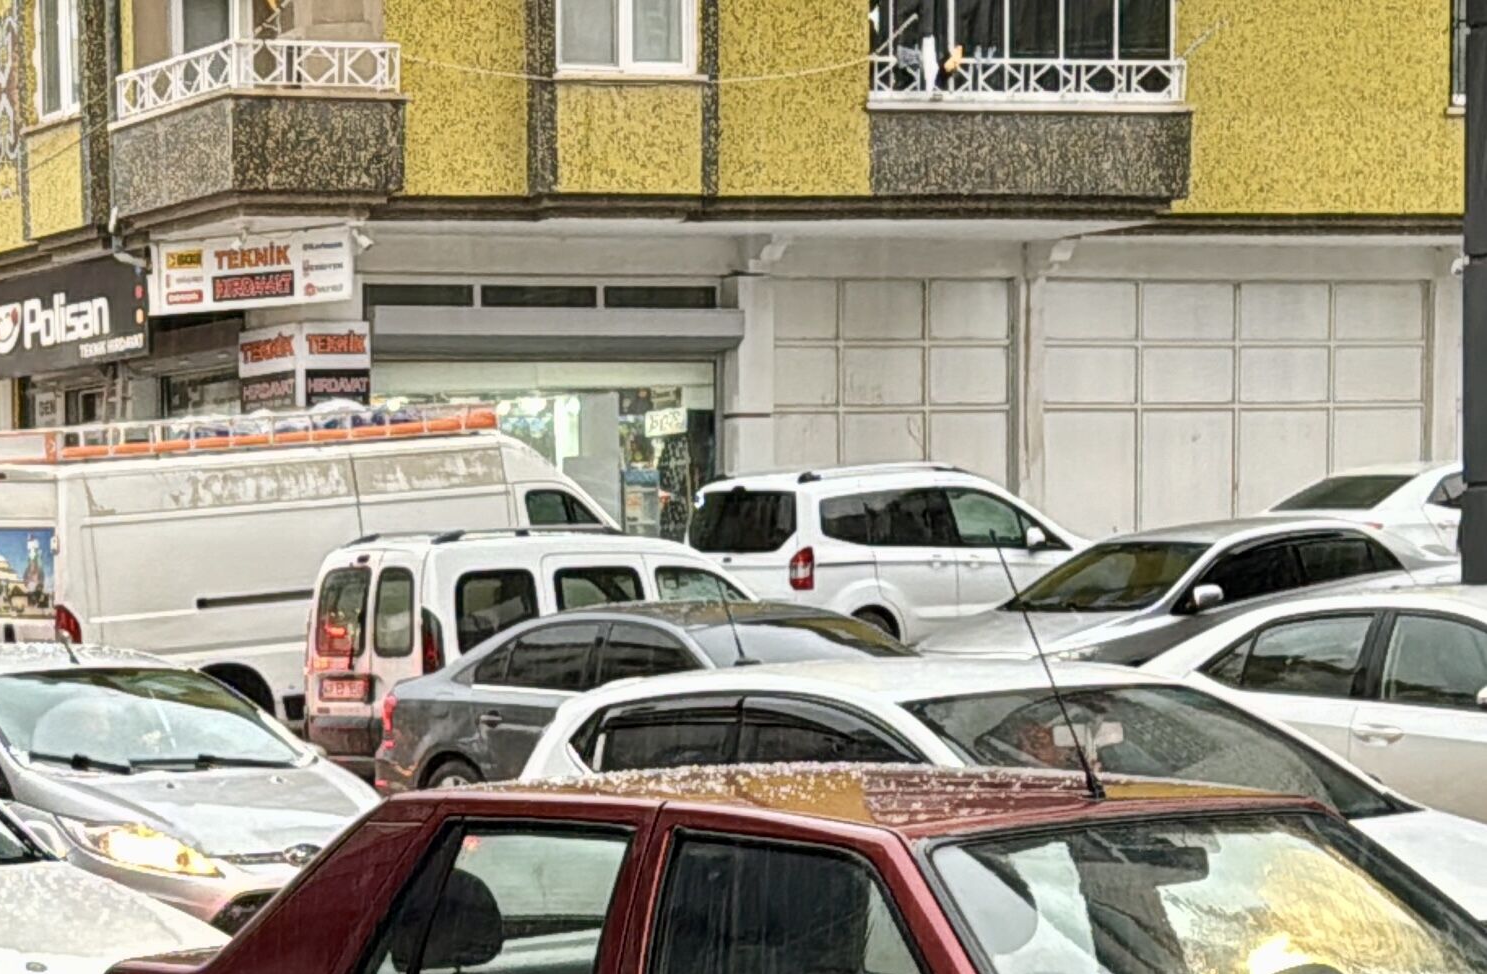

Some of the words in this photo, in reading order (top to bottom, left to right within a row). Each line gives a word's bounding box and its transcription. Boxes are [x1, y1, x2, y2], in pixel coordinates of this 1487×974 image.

[215, 242, 291, 270] TEKNİK
[24, 292, 110, 350] Polisan
[241, 332, 294, 363] TEKNİK
[307, 331, 367, 355] TEKNİK
[307, 377, 369, 393] HIRDAVAT
